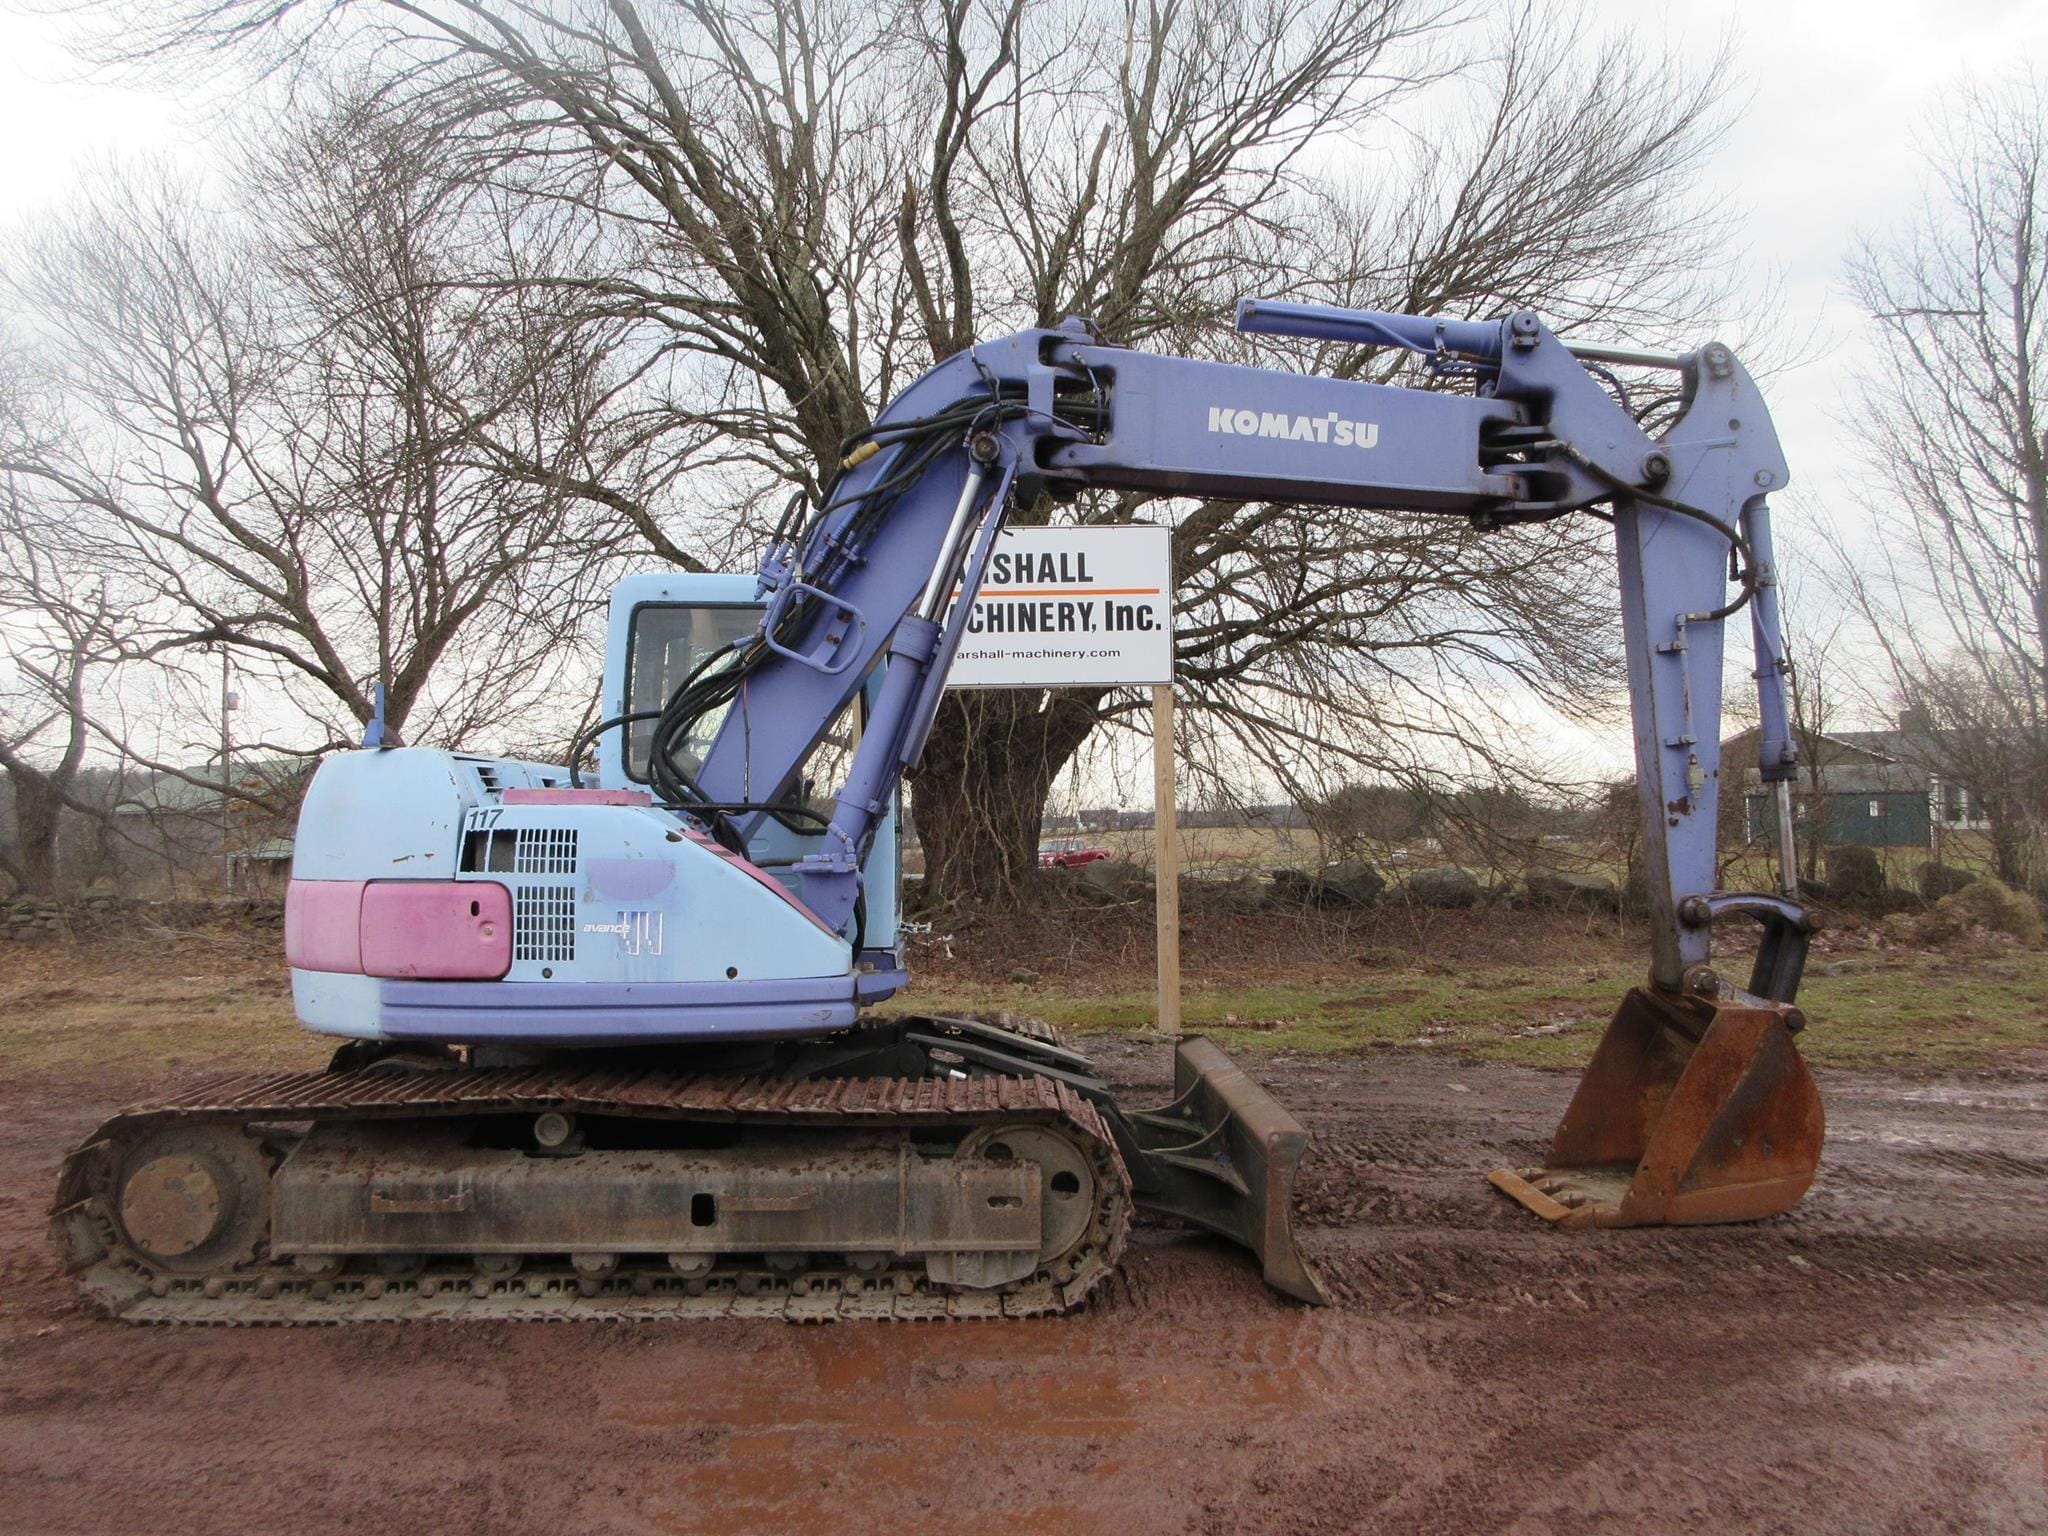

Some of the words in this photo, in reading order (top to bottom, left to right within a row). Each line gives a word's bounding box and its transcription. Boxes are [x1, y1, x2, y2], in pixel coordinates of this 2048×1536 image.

[1208, 407, 1379, 448] KOMATSU
[957, 552, 1094, 585] SHALL
[947, 602, 1097, 634] CHINERY,
[1105, 600, 1162, 632] Inc.
[956, 648, 1121, 660] arshall-machinery.com
[470, 808, 504, 829] 117
[583, 923, 631, 934] avance
